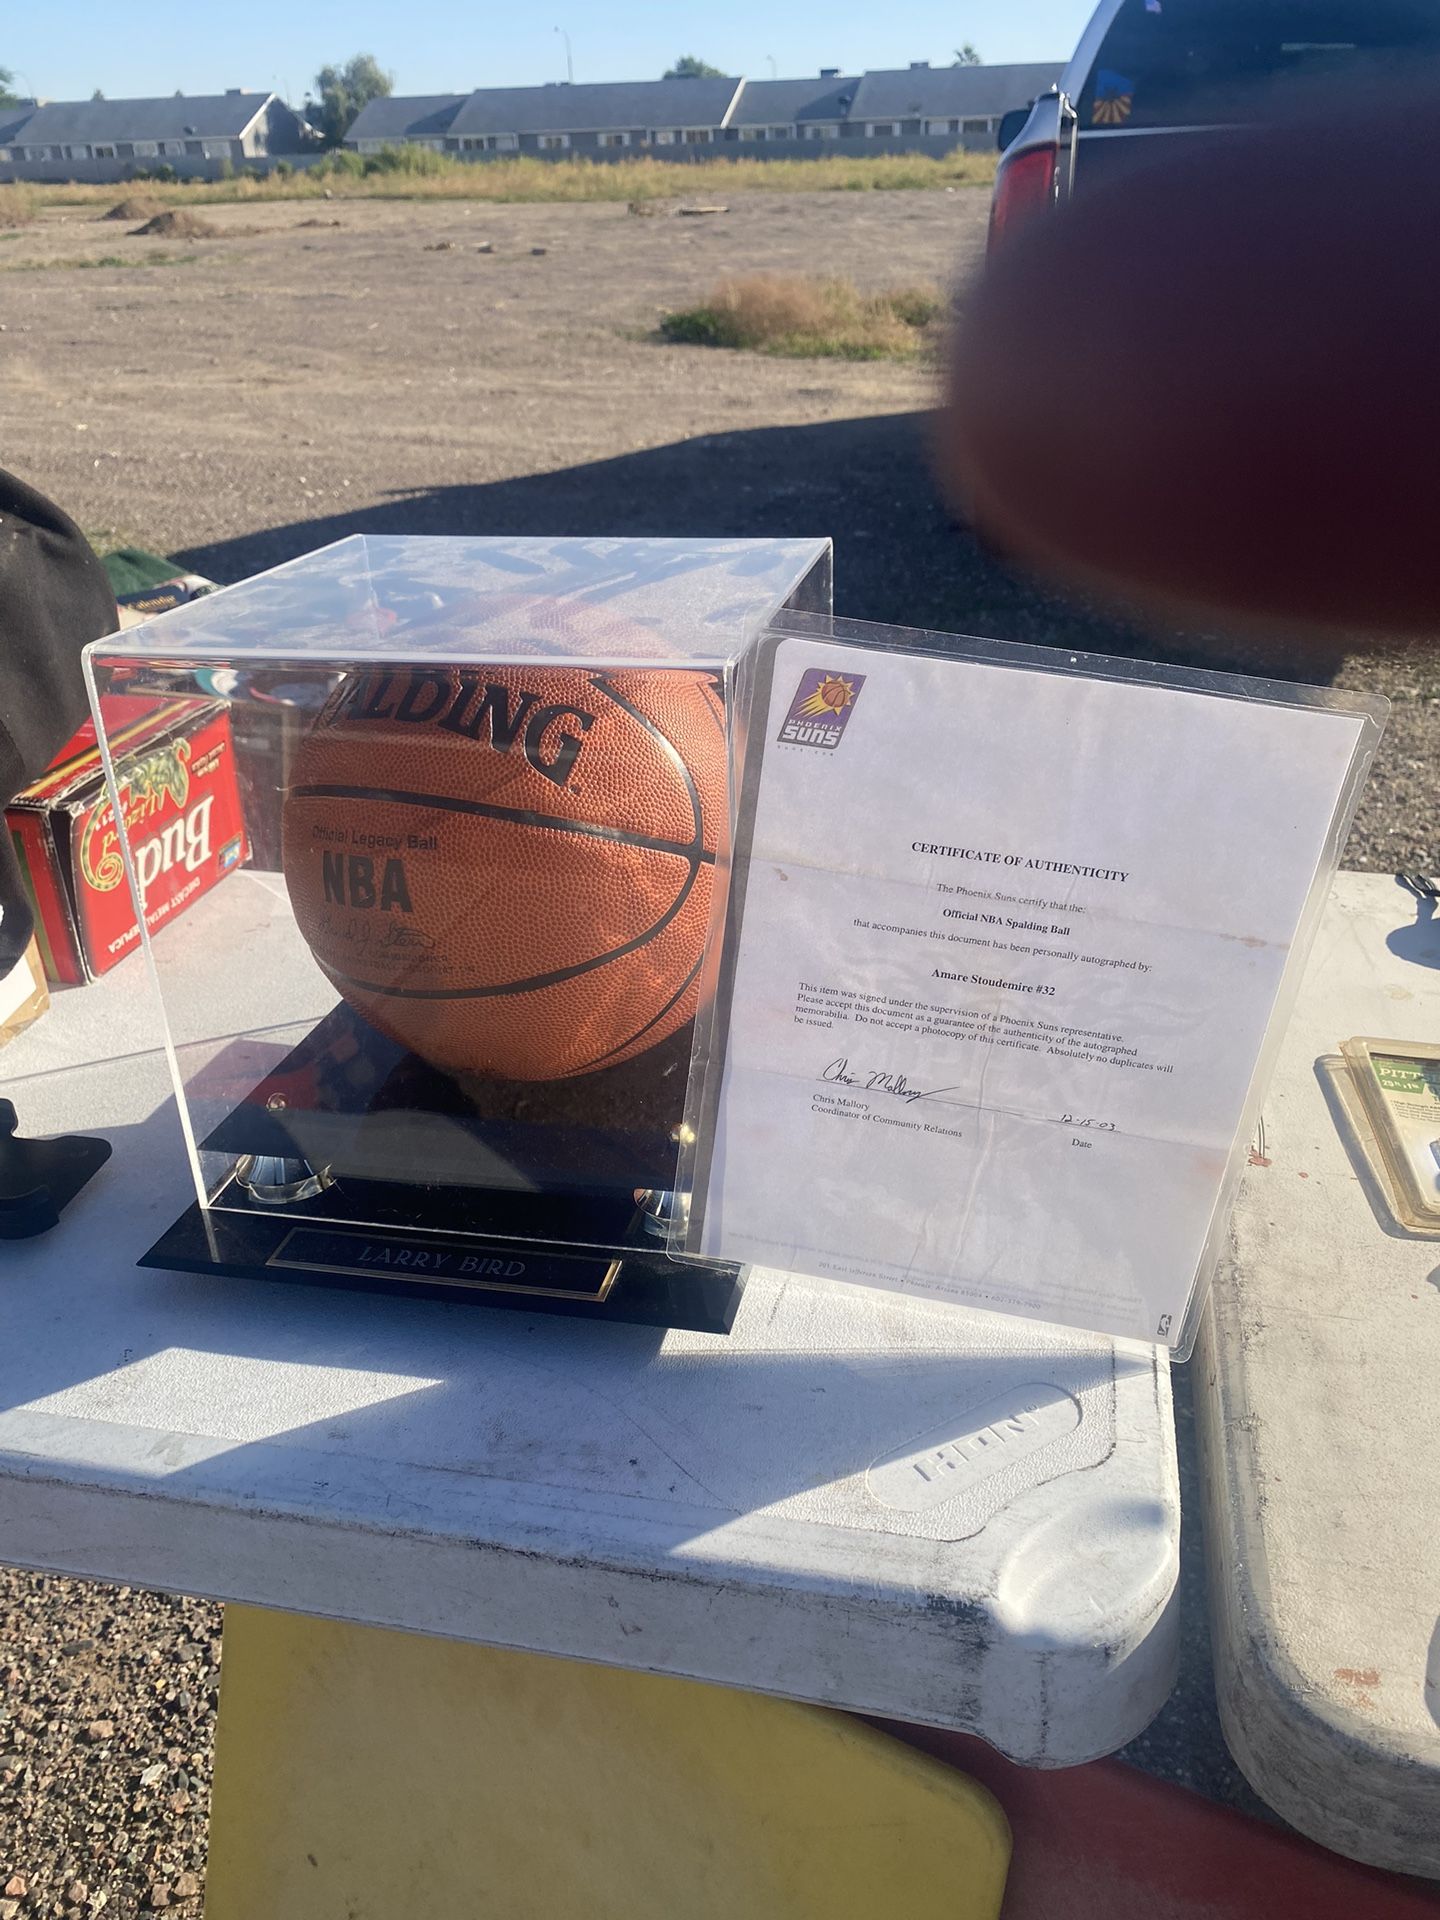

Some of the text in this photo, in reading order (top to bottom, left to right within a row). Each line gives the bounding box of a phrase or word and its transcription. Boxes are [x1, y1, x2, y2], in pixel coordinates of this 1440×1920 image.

[782, 725, 840, 746] SUNS
[788, 719, 842, 732] PHOENIX
[311, 825, 438, 850] Official Legacy Ball
[135, 795, 214, 912] Bud
[911, 841, 1128, 882] CERTIFICATE OF AUTHENTICITY
[322, 850, 413, 913] NBA
[936, 883, 1086, 913] The Phoenix Suns certify that the:
[942, 908, 1070, 935] Official NBA Spalding Ball
[853, 918, 1152, 972] that accompanies this document has been personally autographed by:
[931, 968, 1055, 995] Amare Stoudemire #32
[793, 1014, 833, 1028] be issued.
[797, 992, 823, 1004] Please
[825, 999, 852, 1010] accept
[854, 1002, 869, 1012] this
[871, 1005, 913, 1019] document
[933, 1017, 975, 1029] guarantee
[976, 1023, 987, 1031] of
[988, 1024, 1000, 1033] the
[1003, 1028, 1054, 1044] authenticity
[1055, 1036, 1066, 1044] of
[1067, 1035, 1081, 1046] the
[1082, 1041, 1137, 1056] autographed
[798, 981, 817, 992] This
[819, 987, 838, 995] item
[840, 990, 856, 998] was
[858, 992, 887, 1003] signed
[888, 998, 913, 1007] under
[914, 1001, 928, 1010] the
[930, 1005, 978, 1018] supervision
[980, 1012, 991, 1020] of
[999, 1014, 1034, 1027] Phoenix
[1036, 1020, 1058, 1031] Suns
[1060, 1026, 1123, 1042] representative.
[795, 1005, 849, 1019] memorabilia.
[854, 1013, 868, 1022] Do
[885, 1021, 912, 1031] accept
[920, 1025, 966, 1040] photocopy
[979, 1034, 994, 1044] this
[996, 1038, 1040, 1051] certificate.
[1046, 1046, 1094, 1062] Absolutely
[1095, 1055, 1107, 1063] no
[1109, 1056, 1153, 1070] duplicates
[1156, 1064, 1173, 1072] will
[812, 1093, 869, 1111] Chris Mallory
[811, 1104, 860, 1119] Coordinator
[872, 1114, 921, 1131] Community
[923, 1123, 962, 1137] Relations
[1071, 1137, 1092, 1148] Date
[358, 1246, 527, 1278] LARRY BIRD
